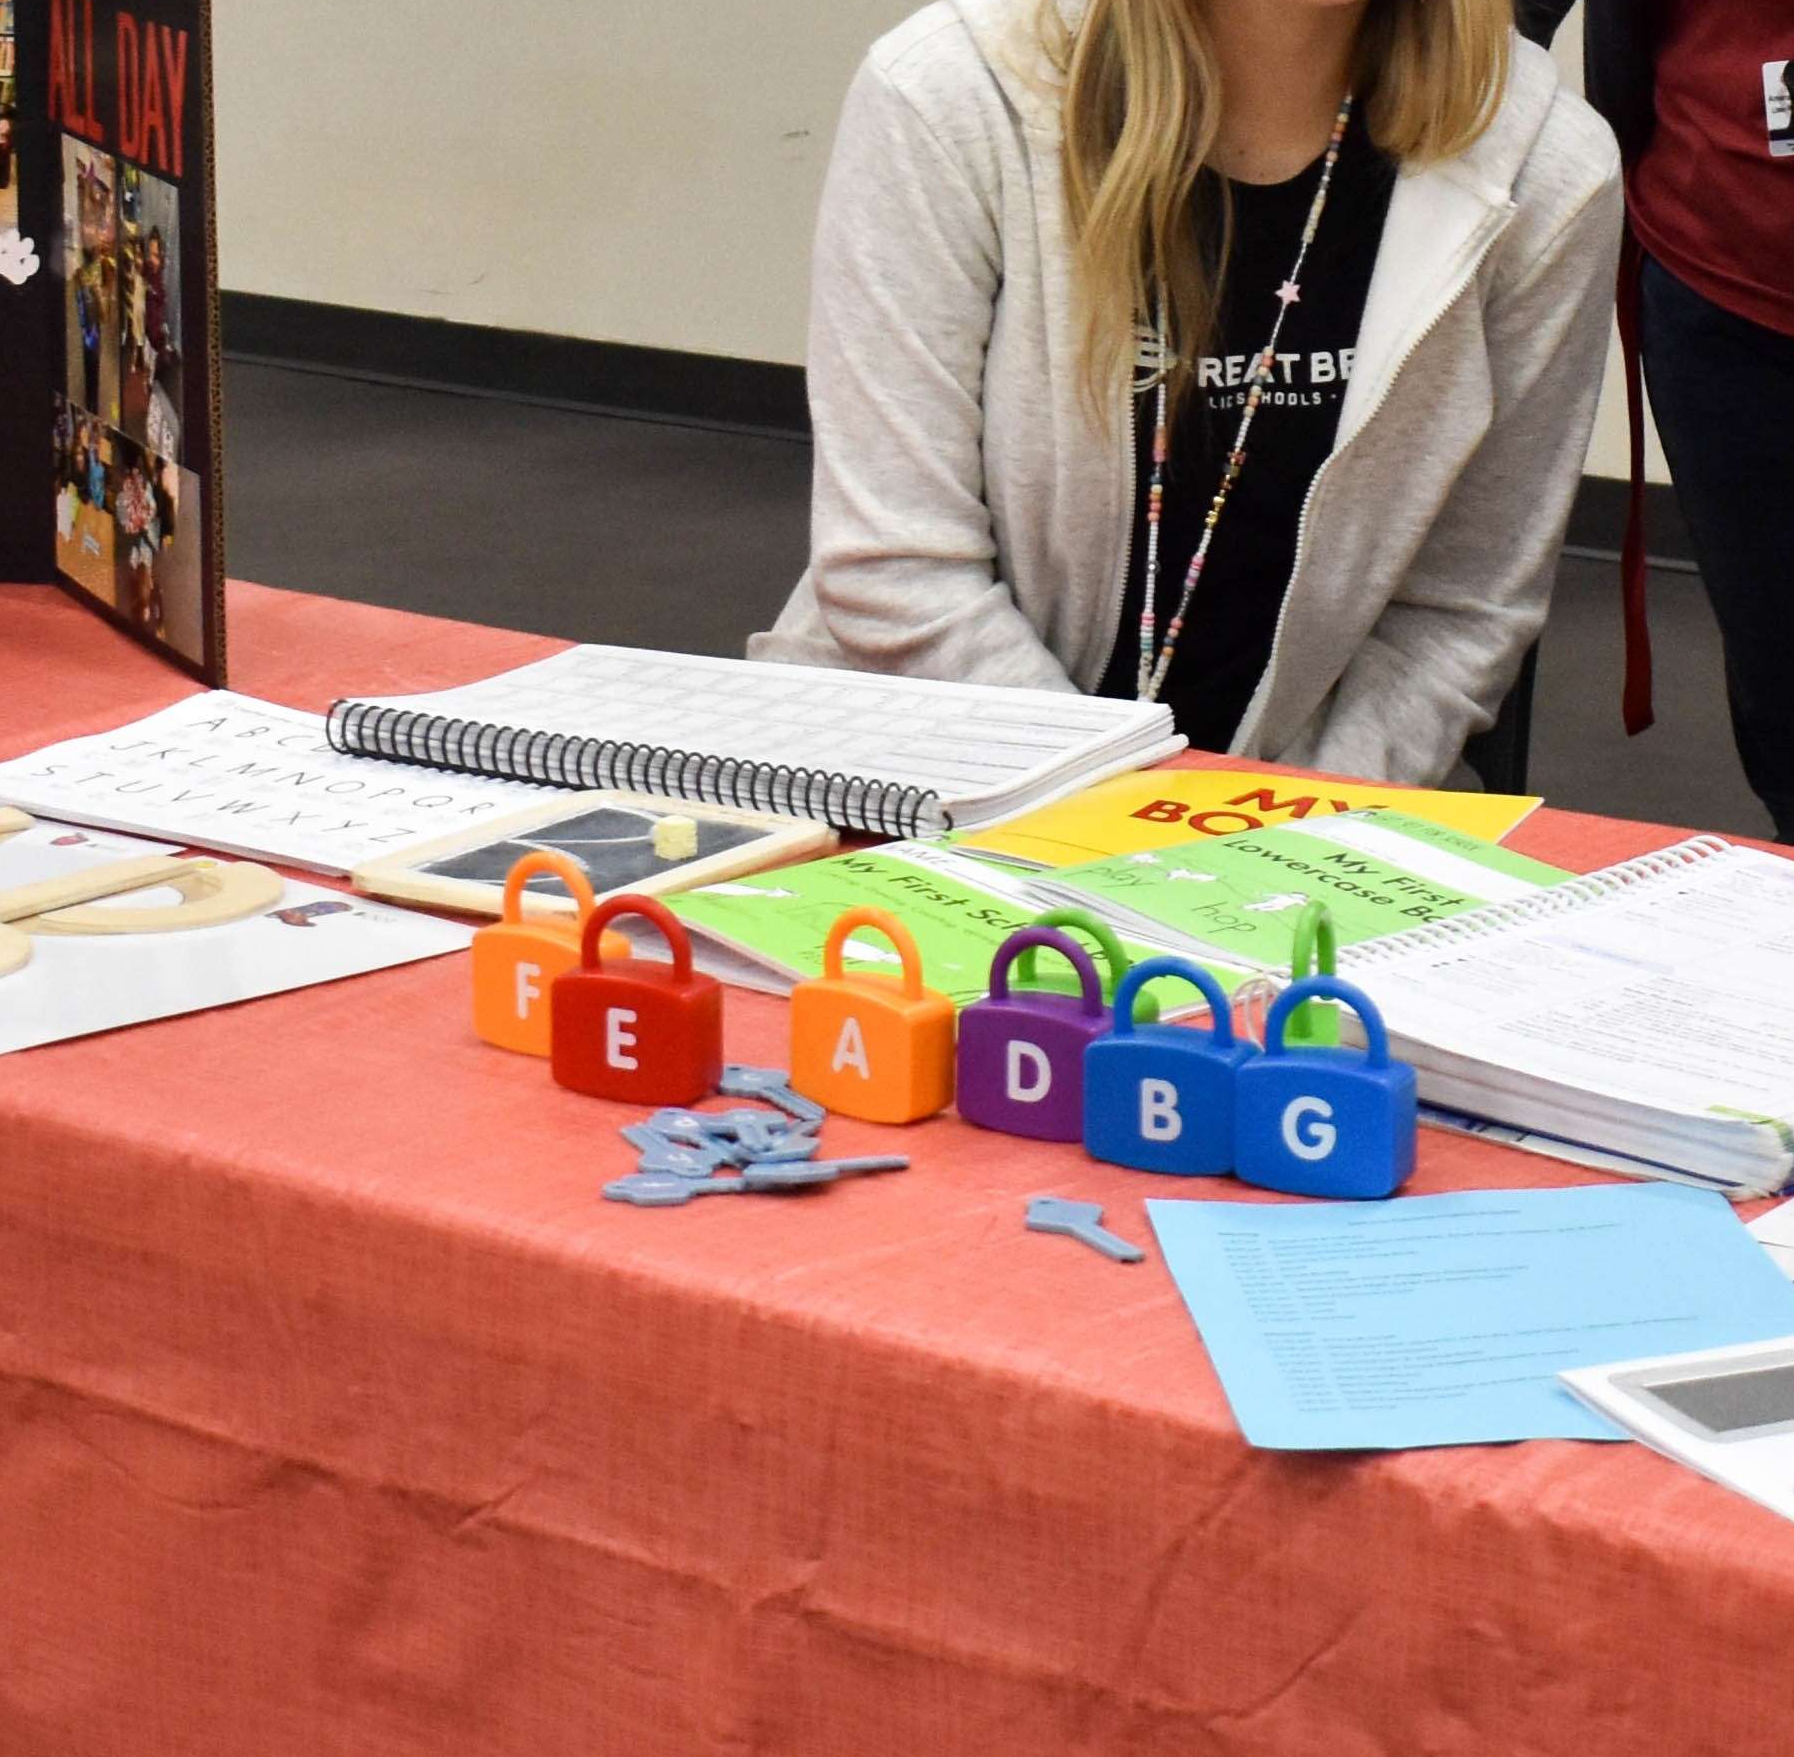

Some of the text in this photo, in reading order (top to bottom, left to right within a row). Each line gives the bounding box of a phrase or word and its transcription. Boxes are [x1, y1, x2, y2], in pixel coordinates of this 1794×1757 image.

[116, 11, 188, 178] DAY
[1197, 351, 1301, 388] REAT
[1236, 390, 1322, 406] SHOOLS
[188, 716, 227, 731] A
[235, 726, 270, 738] B
[30, 764, 416, 843] S T U V W X Y Z
[147, 747, 191, 759] K
[188, 754, 219, 767] L
[226, 762, 280, 778] M
[274, 771, 325, 785] N
[325, 780, 366, 793] O
[368, 786, 406, 799] P
[412, 795, 454, 808] Q
[459, 801, 496, 815] R
[831, 857, 888, 874] My
[886, 874, 971, 907] First
[1222, 838, 1396, 907] Lowercase
[1322, 851, 1466, 908] My First
[1190, 900, 1258, 934] hop
[515, 960, 542, 1020] F
[605, 1006, 639, 1072] E
[832, 1016, 871, 1081] A
[1006, 1038, 1053, 1104] D
[1139, 1077, 1183, 1144] B
[1280, 1094, 1338, 1161] G
